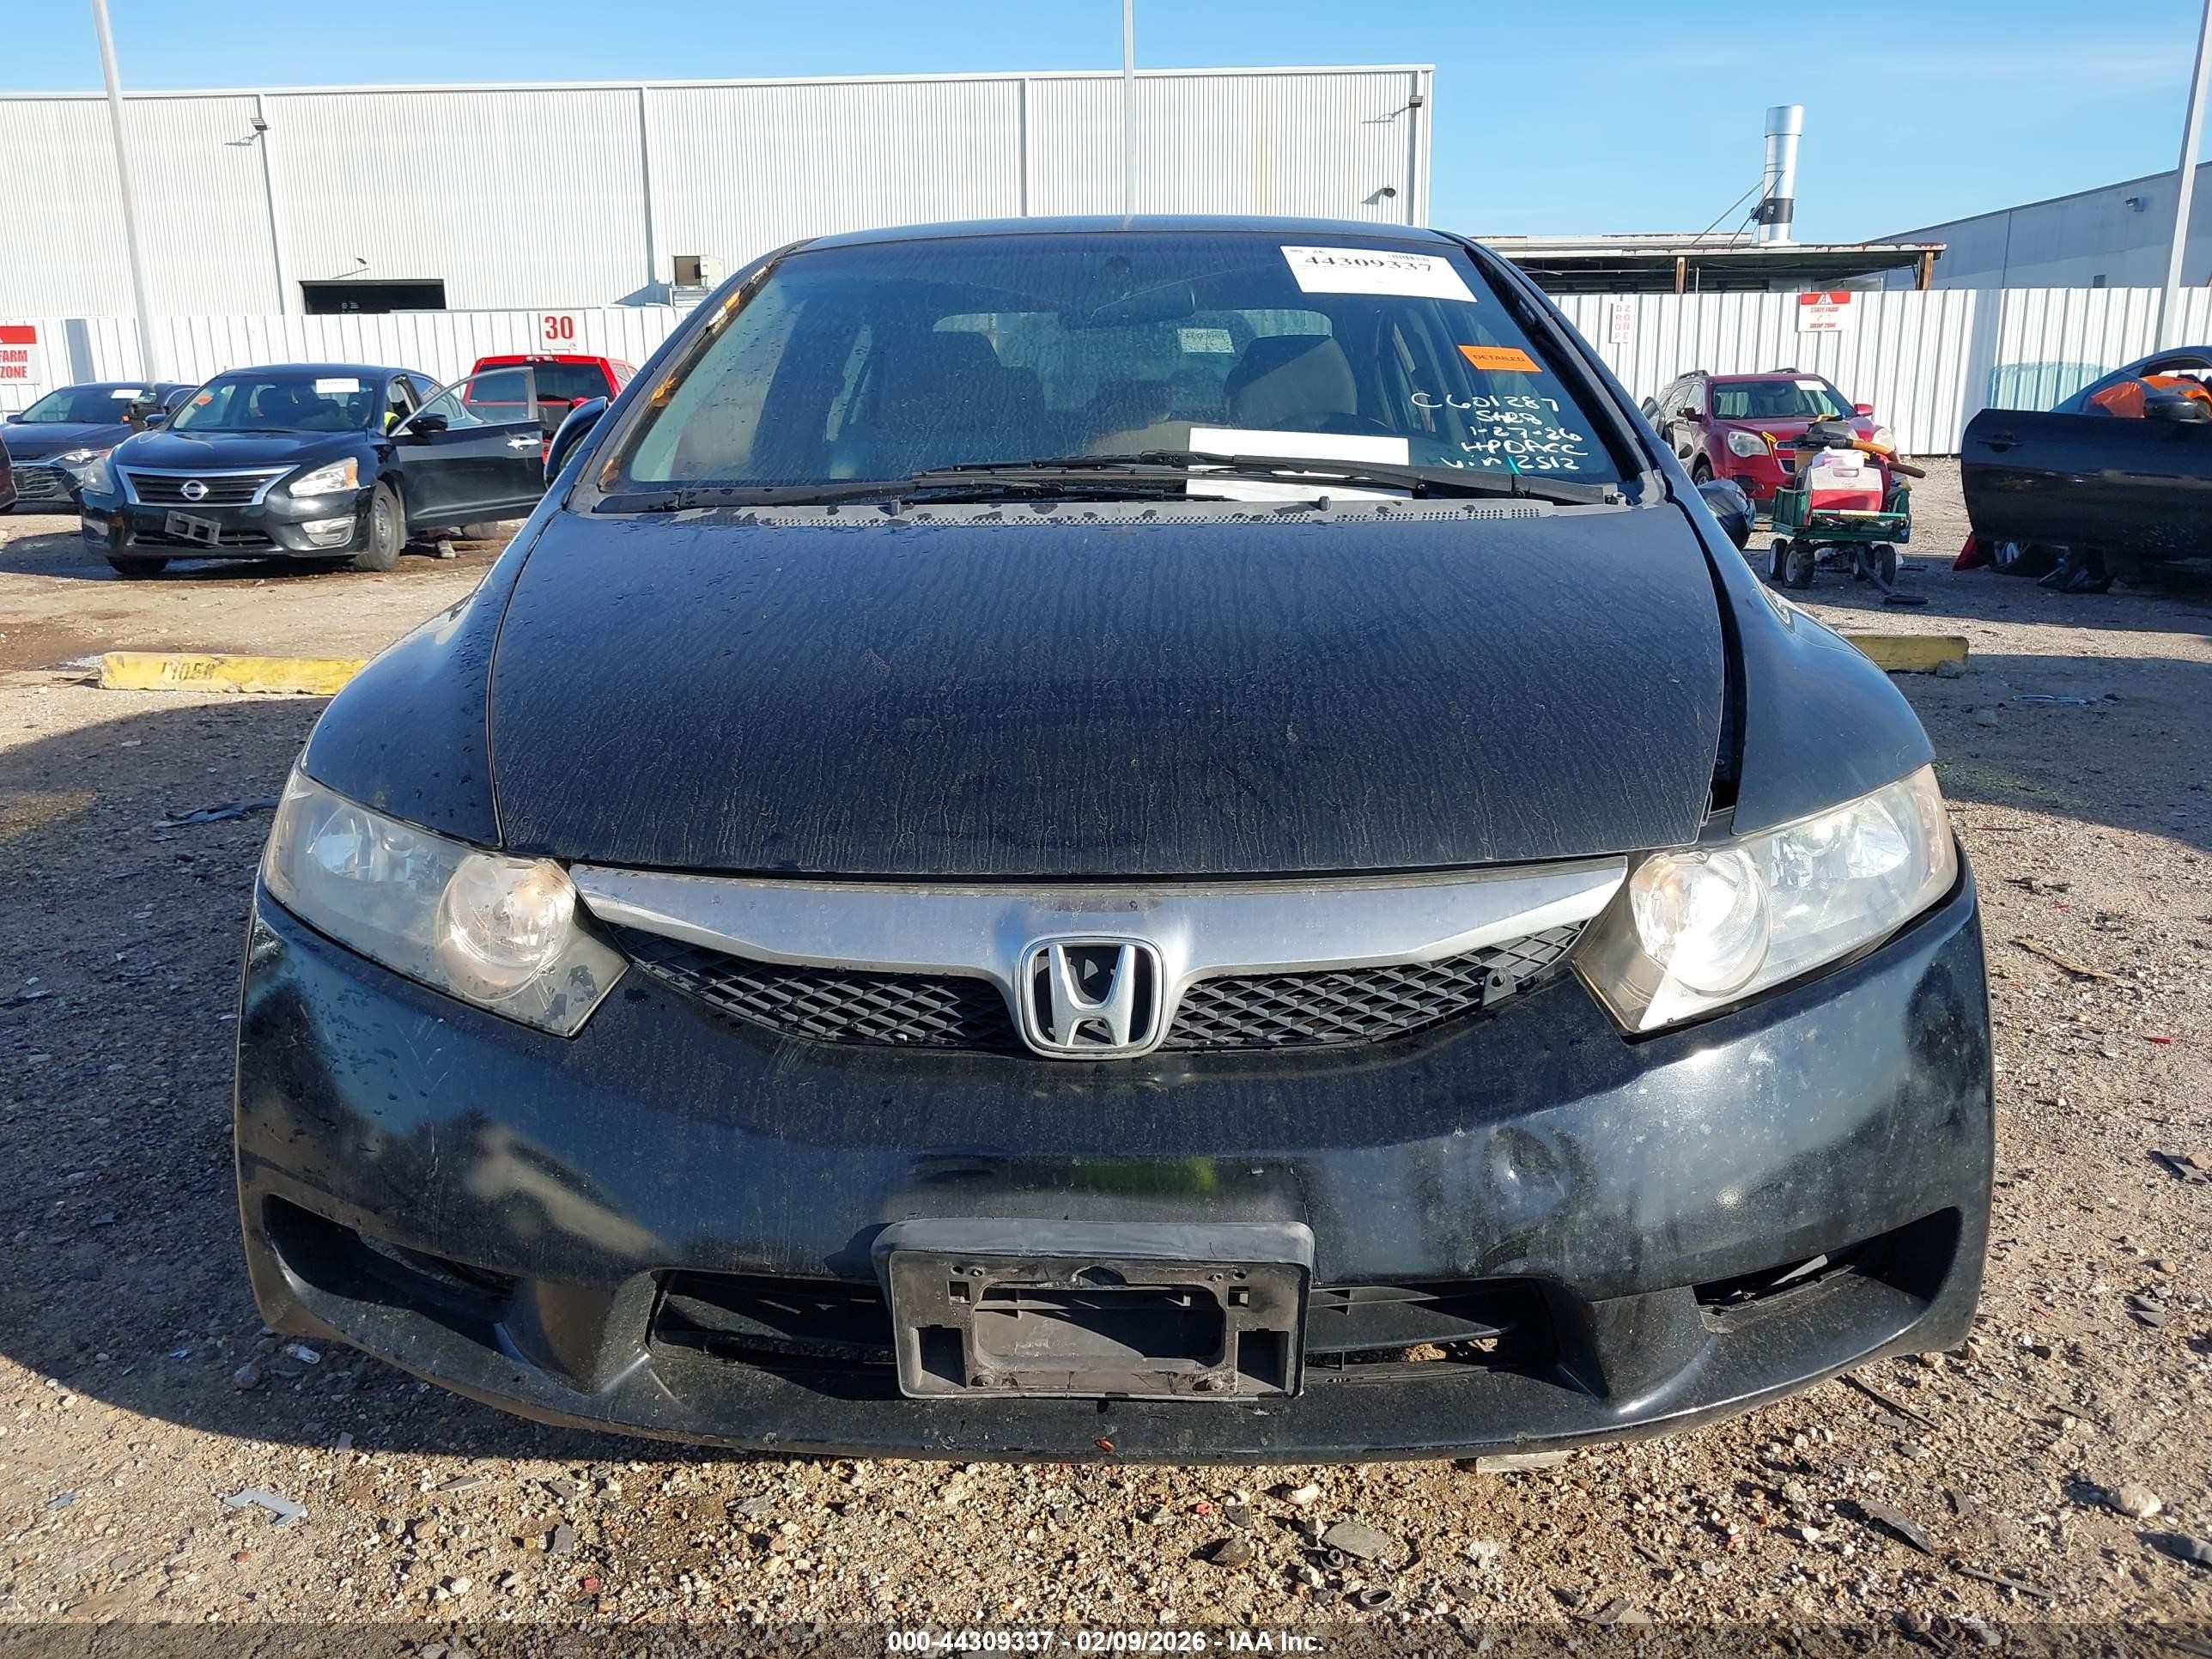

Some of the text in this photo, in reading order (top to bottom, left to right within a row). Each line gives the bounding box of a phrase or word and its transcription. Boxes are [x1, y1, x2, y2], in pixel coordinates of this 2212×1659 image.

[1304, 256, 1431, 272] 44309337
[544, 316, 574, 340] 30
[1473, 354, 1526, 362] DETAILED
[0, 366, 27, 379] ZONE
